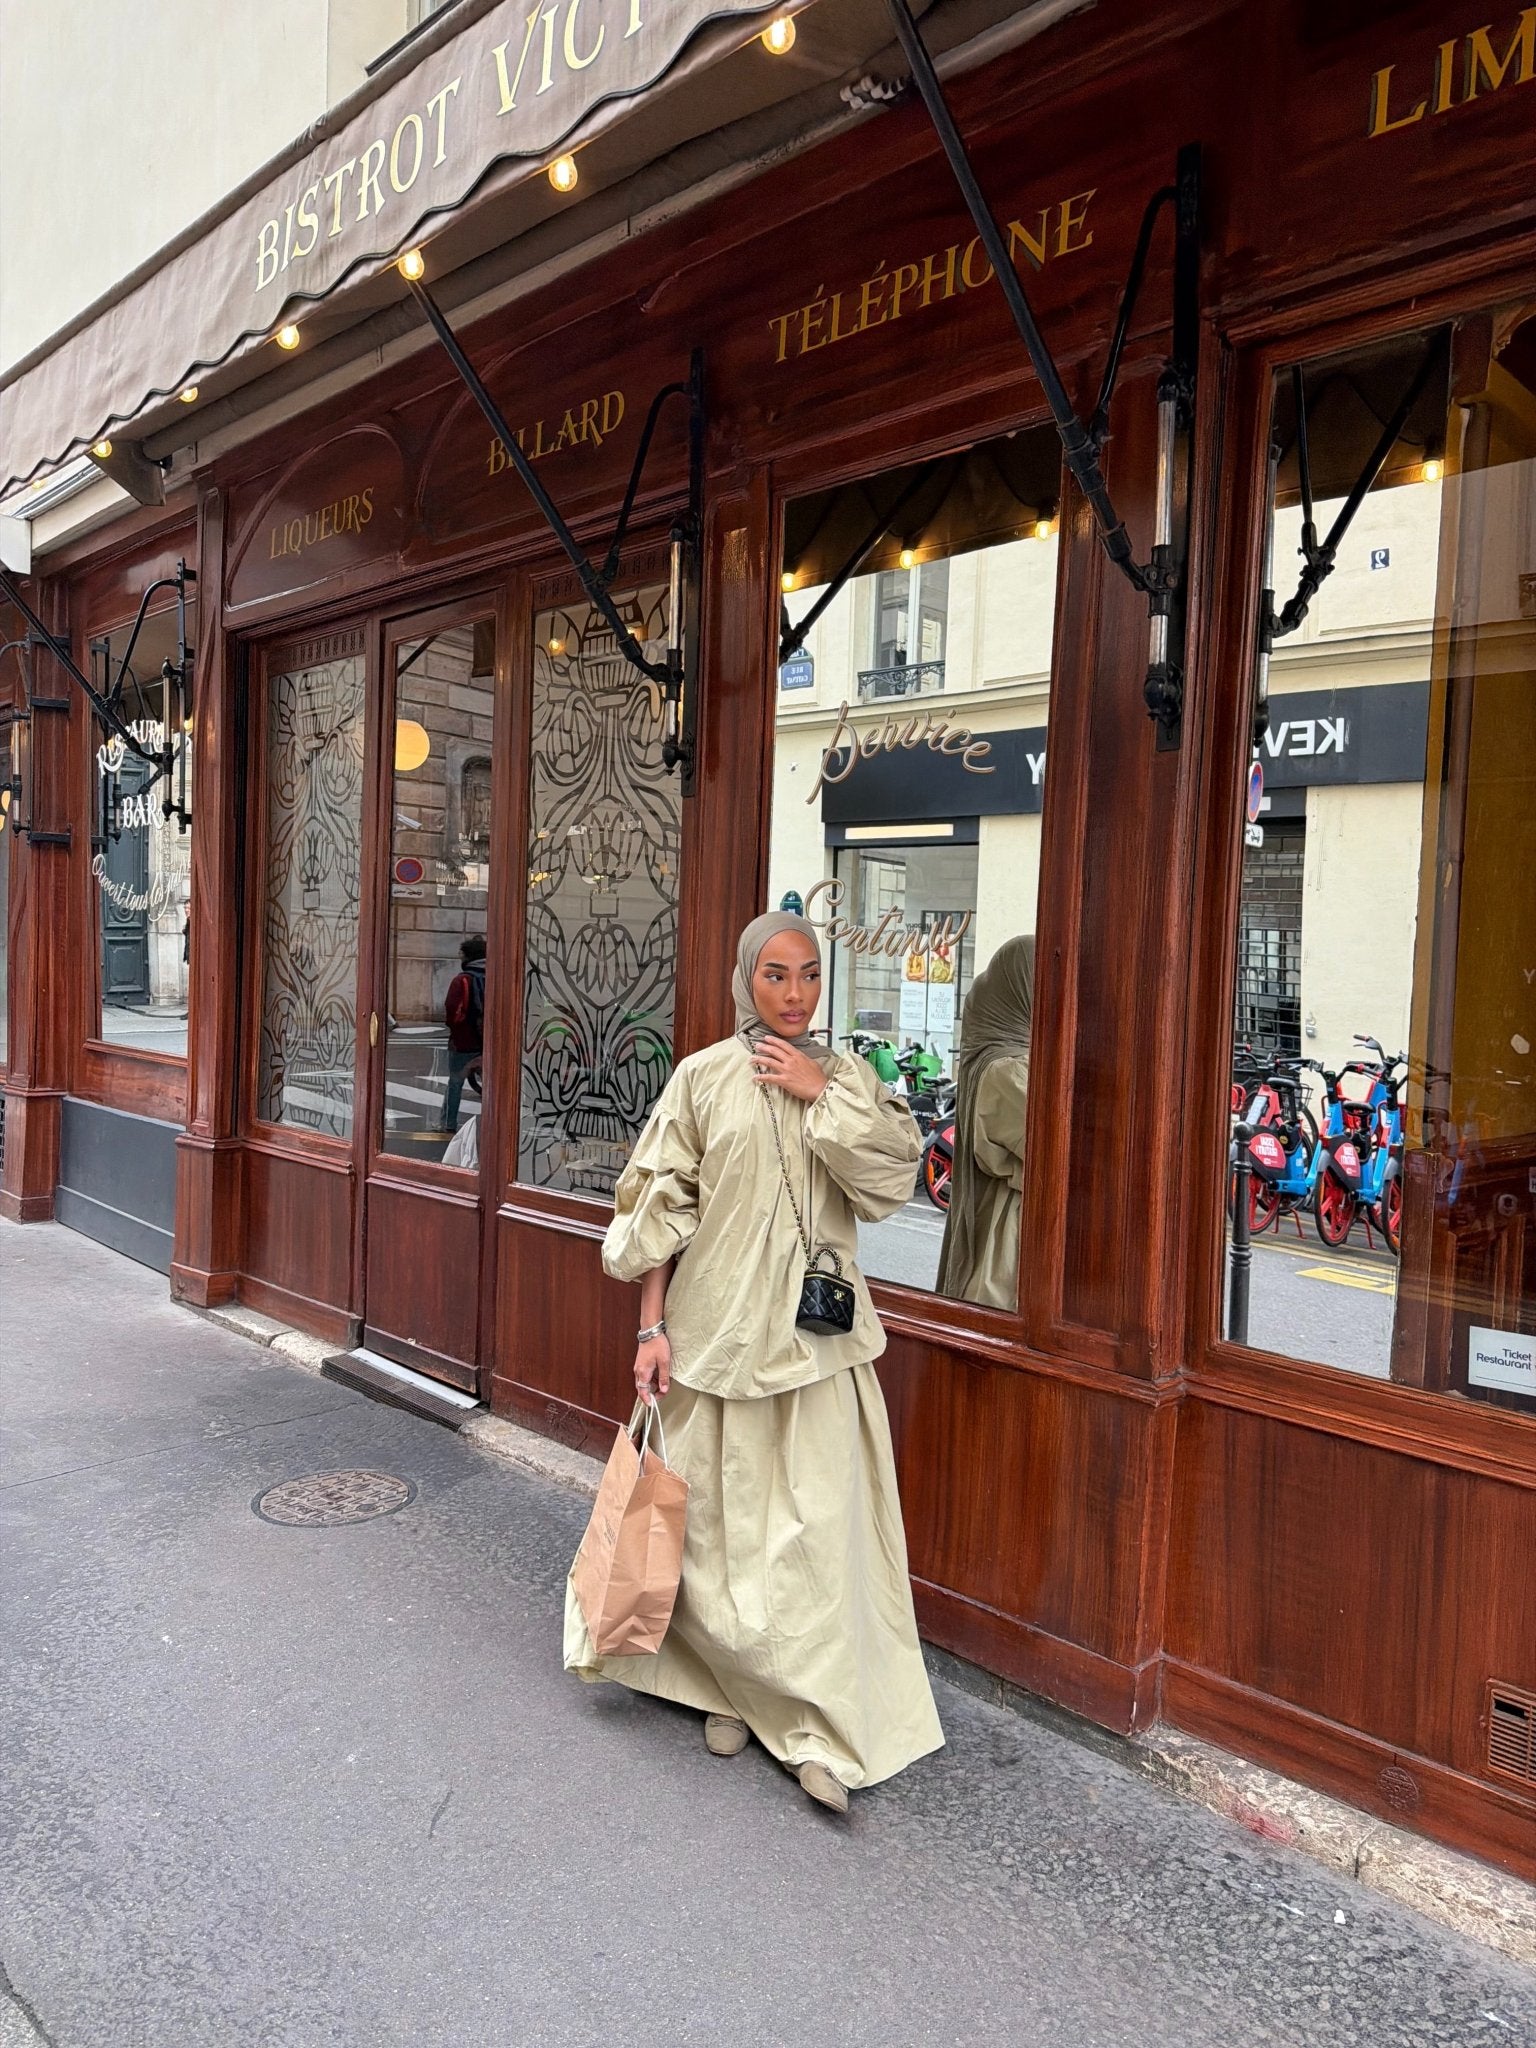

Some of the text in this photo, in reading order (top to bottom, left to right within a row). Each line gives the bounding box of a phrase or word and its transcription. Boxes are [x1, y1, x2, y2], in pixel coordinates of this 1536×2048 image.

[254, 75, 463, 293] BISTROT
[767, 187, 1099, 364] TÉLÉPHONE
[269, 486, 375, 560] LIQUEURS
[96, 719, 192, 779] RESAUR
[805, 700, 996, 805] Service
[122, 793, 164, 830] BAR
[804, 877, 972, 957] Continu
[1476, 1352, 1532, 1371] Restaurant
[1502, 1348, 1532, 1362] Ticket
